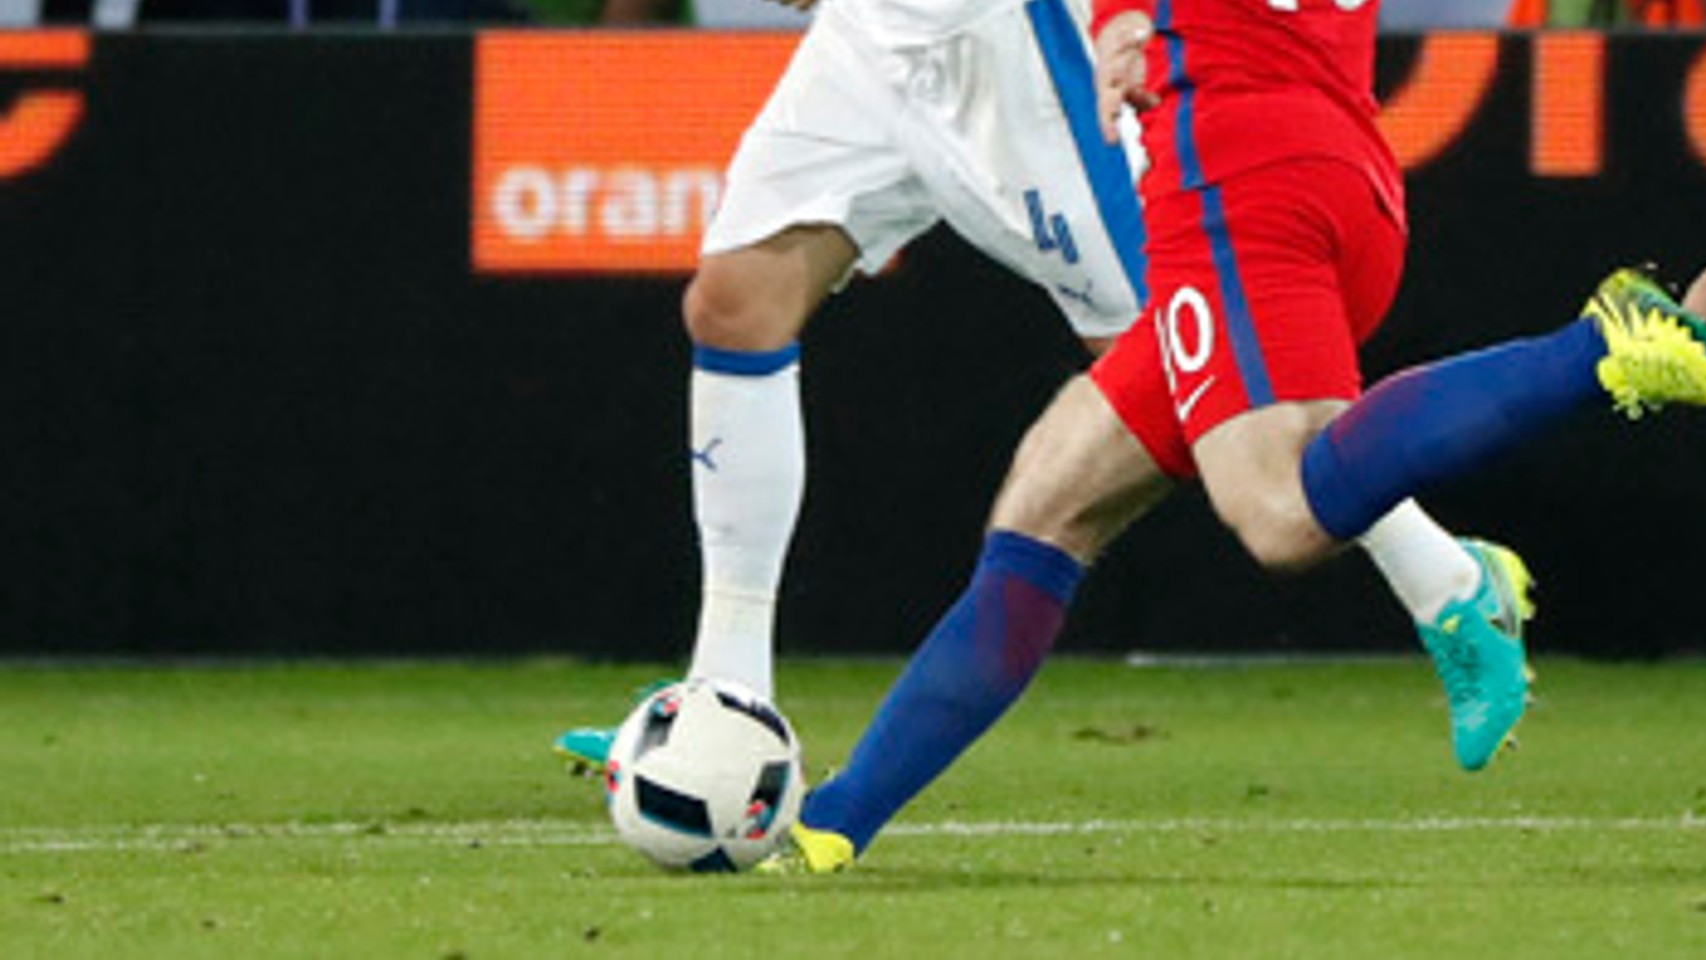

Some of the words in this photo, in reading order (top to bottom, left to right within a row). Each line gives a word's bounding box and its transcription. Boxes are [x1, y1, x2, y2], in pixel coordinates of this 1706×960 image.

[491, 166, 722, 242] oran
[1023, 189, 1080, 265] 4
[1155, 286, 1215, 396] 10
